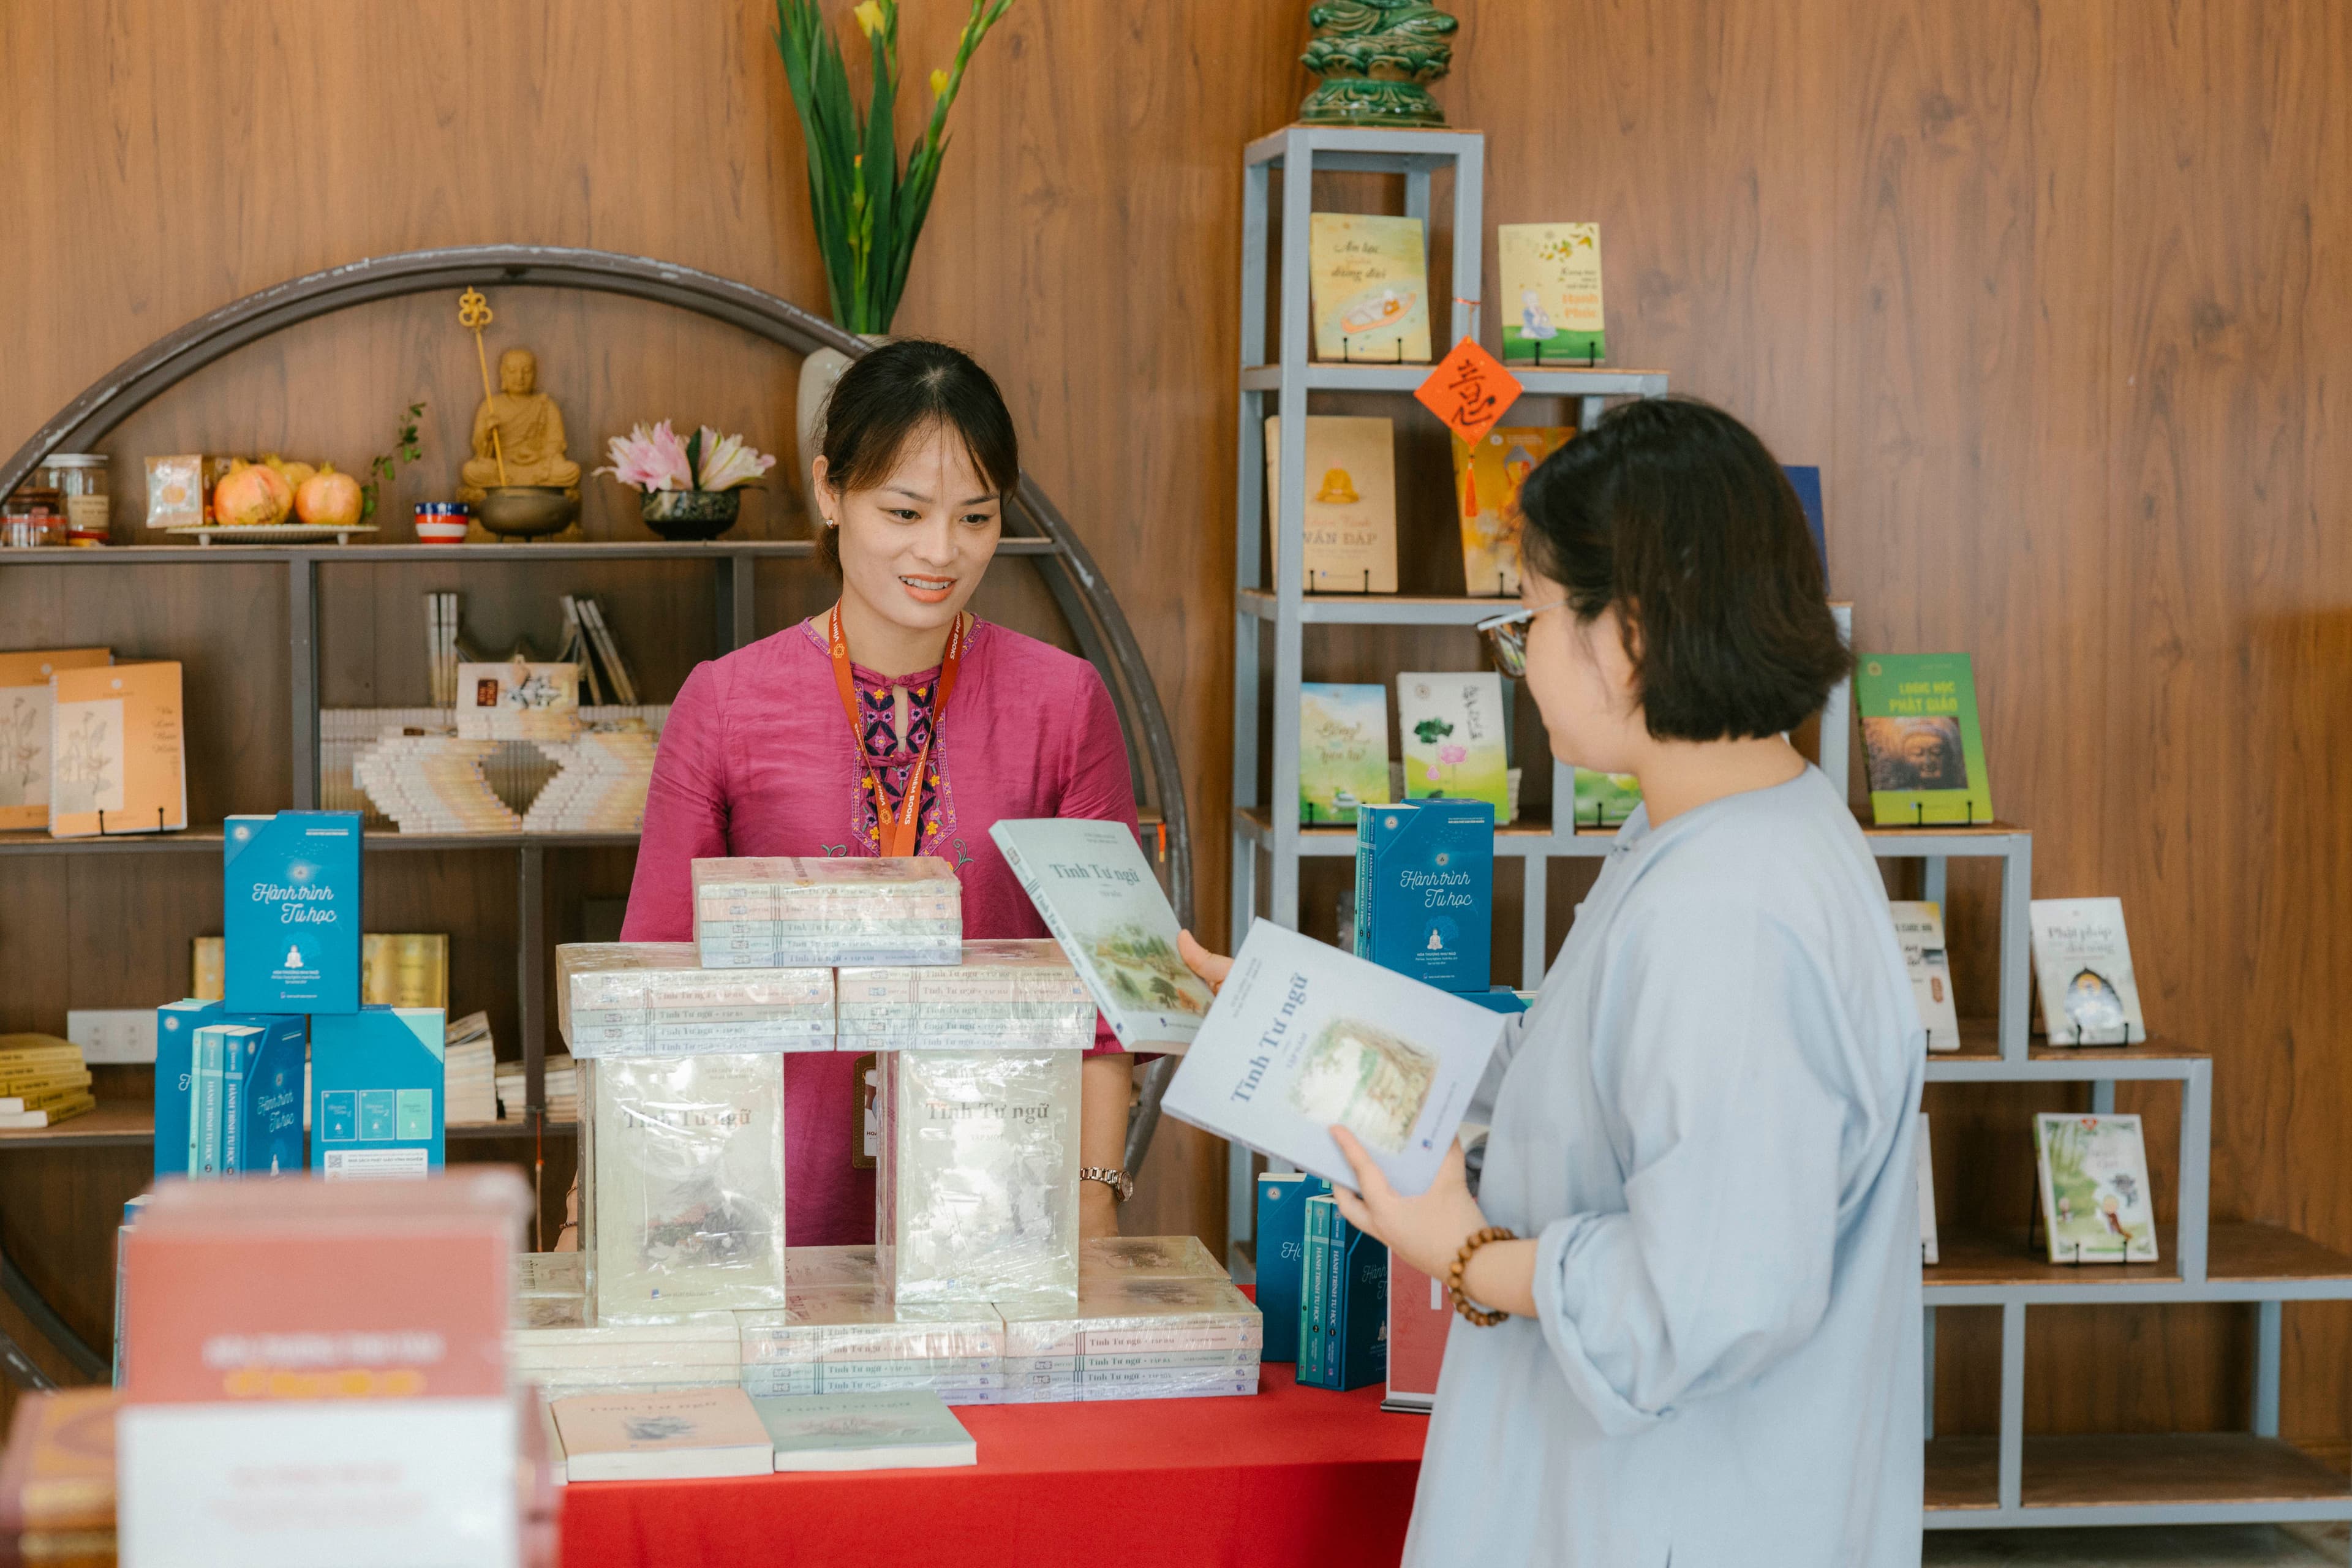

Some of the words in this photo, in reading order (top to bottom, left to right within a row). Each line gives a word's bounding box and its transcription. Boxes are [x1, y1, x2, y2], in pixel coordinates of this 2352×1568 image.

[950, 633, 959, 660] BOOKS
[904, 795, 915, 826] BOOKS
[1400, 870, 1438, 890] Hành
[1438, 870, 1471, 886] trình
[252, 883, 298, 904] Hành
[297, 884, 334, 900] trình
[1425, 889, 1447, 908] Tu
[1446, 892, 1472, 908] học
[281, 903, 307, 924] Tu
[306, 906, 337, 924] học
[1230, 1055, 1271, 1102] Tĩnh
[1259, 1017, 1287, 1047] Tư
[1281, 971, 1309, 1017] ngữ
[979, 1102, 1006, 1119] Tư
[1011, 1102, 1050, 1123] ngữ
